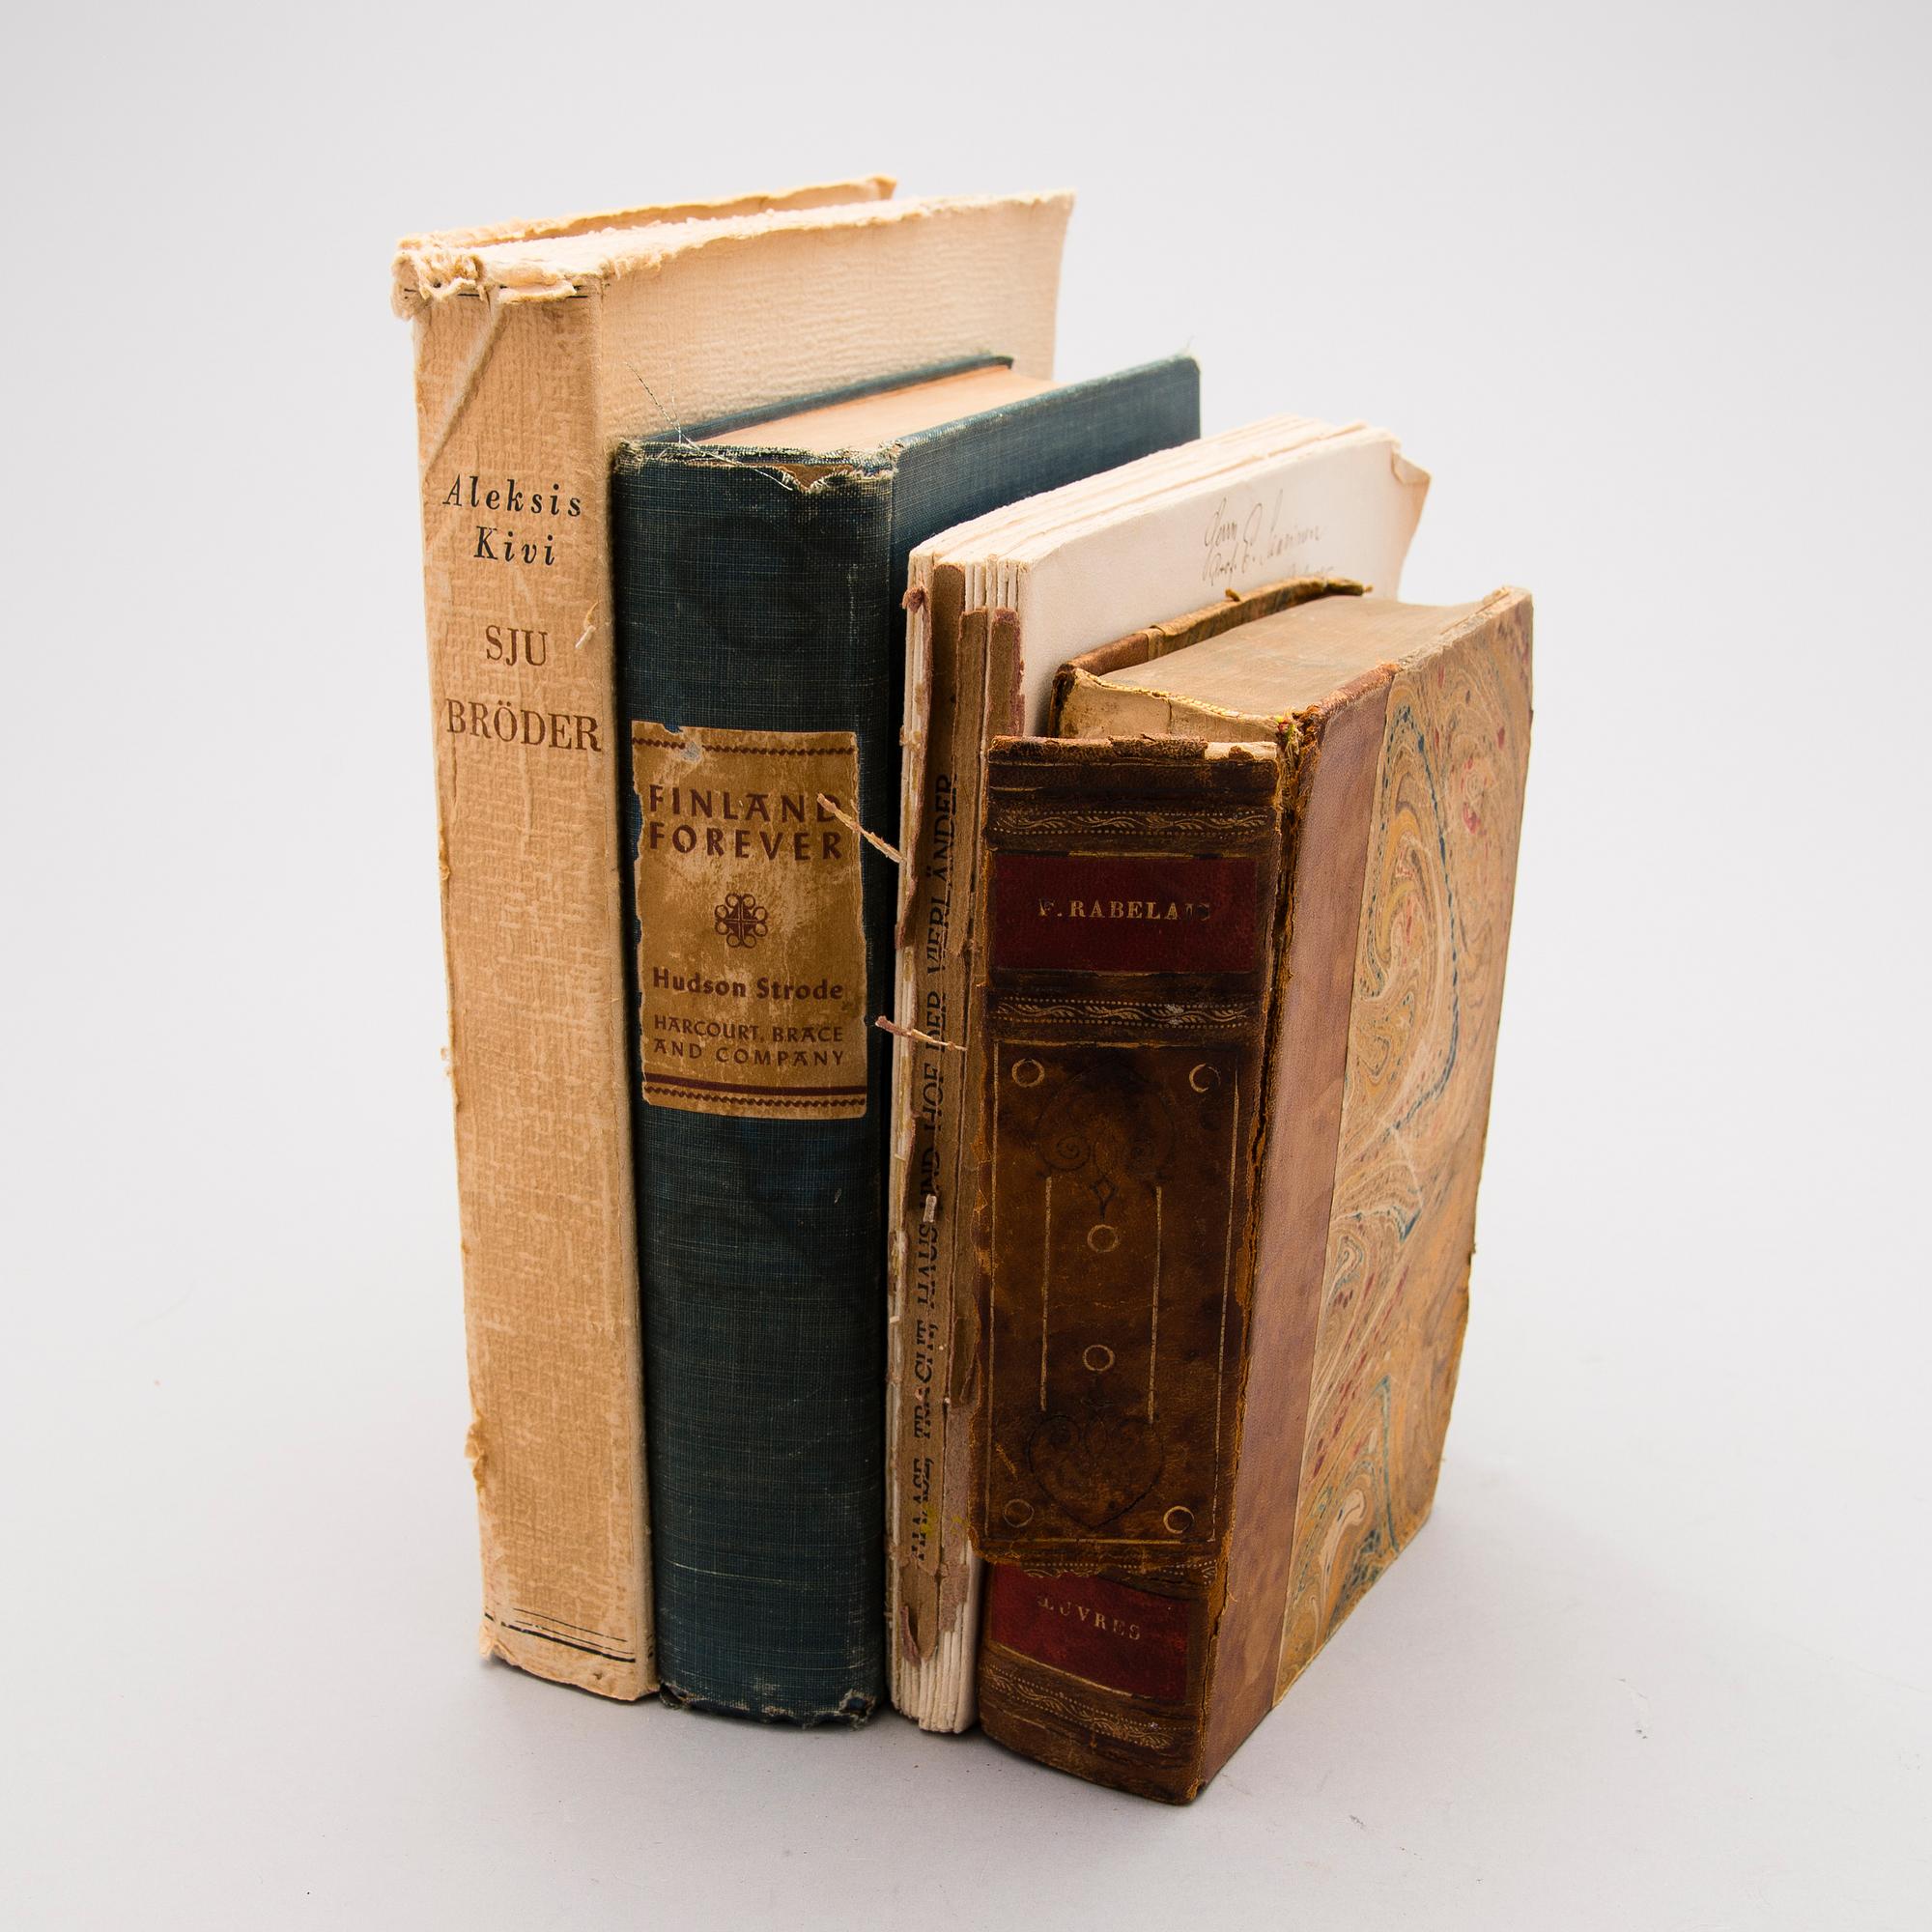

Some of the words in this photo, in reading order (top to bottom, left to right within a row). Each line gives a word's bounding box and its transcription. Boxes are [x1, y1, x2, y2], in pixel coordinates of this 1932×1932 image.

[441, 472, 582, 517] Aleksis
[473, 525, 555, 566] Kivi
[485, 624, 549, 667] SJU
[445, 697, 602, 753] BRÖDER
[649, 783, 842, 824] FINLAND
[649, 820, 843, 862] FOREVER
[652, 966, 748, 999] Hudson
[755, 976, 844, 1002] Strode
[772, 1026, 843, 1043] BRACE
[925, 991, 947, 1053] DER
[654, 1037, 703, 1060] AND
[715, 1046, 844, 1066] COMPANY
[923, 1063, 944, 1131] HOF
[920, 1150, 941, 1210] ND
